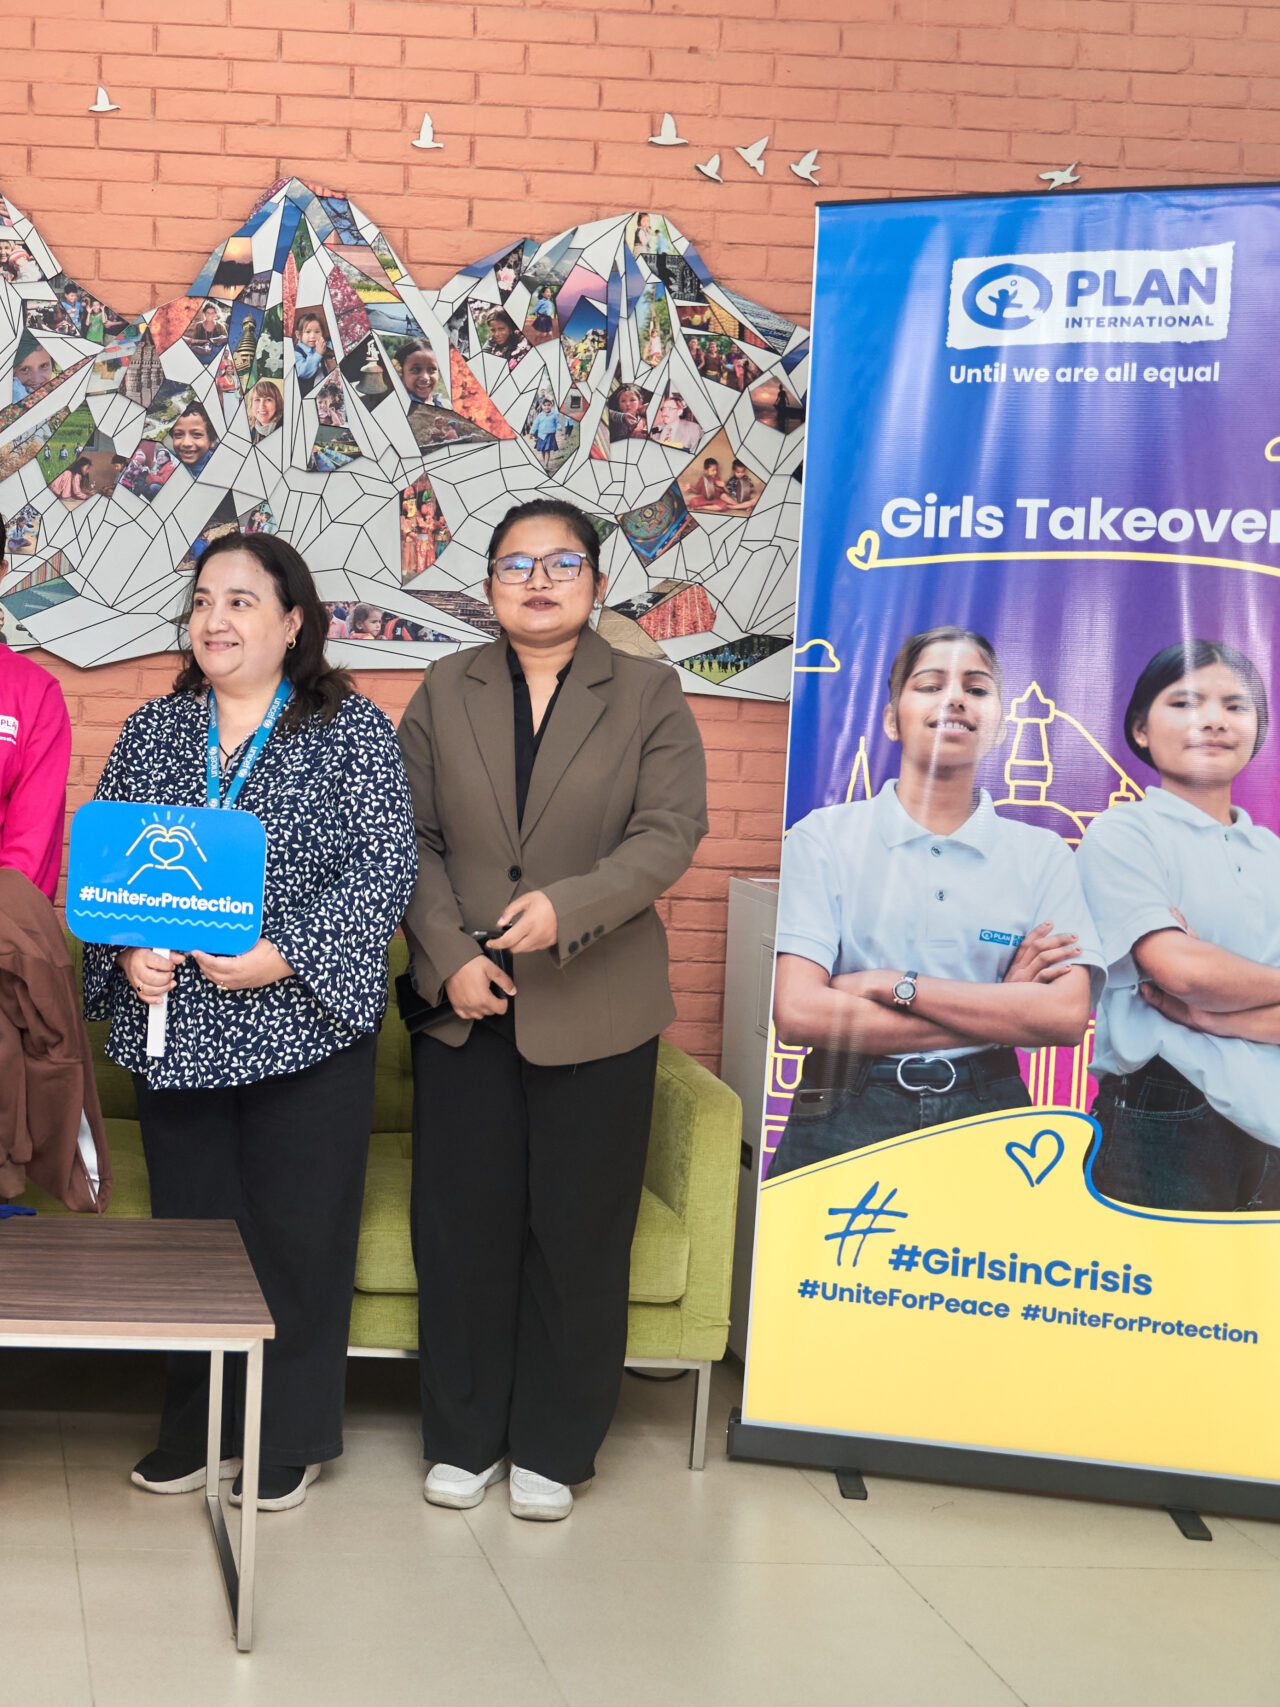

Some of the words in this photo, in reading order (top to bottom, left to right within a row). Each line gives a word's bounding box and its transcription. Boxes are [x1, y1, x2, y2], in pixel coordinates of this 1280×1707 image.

[1065, 267, 1218, 308] PLAN
[1065, 313, 1214, 330] INTERNATIONAL
[950, 362, 1008, 384] Until
[1013, 367, 1051, 384] we
[1055, 367, 1099, 383] are
[1104, 362, 1137, 383] all
[1143, 361, 1220, 389] equal
[881, 492, 1004, 540] Girls
[79, 884, 254, 916] #UniteForProtection
[888, 1243, 1153, 1296] #GirlsinCrisis
[797, 1278, 1010, 1319] #UniteForPeace
[1020, 1302, 1258, 1345] #UniteForProtection
